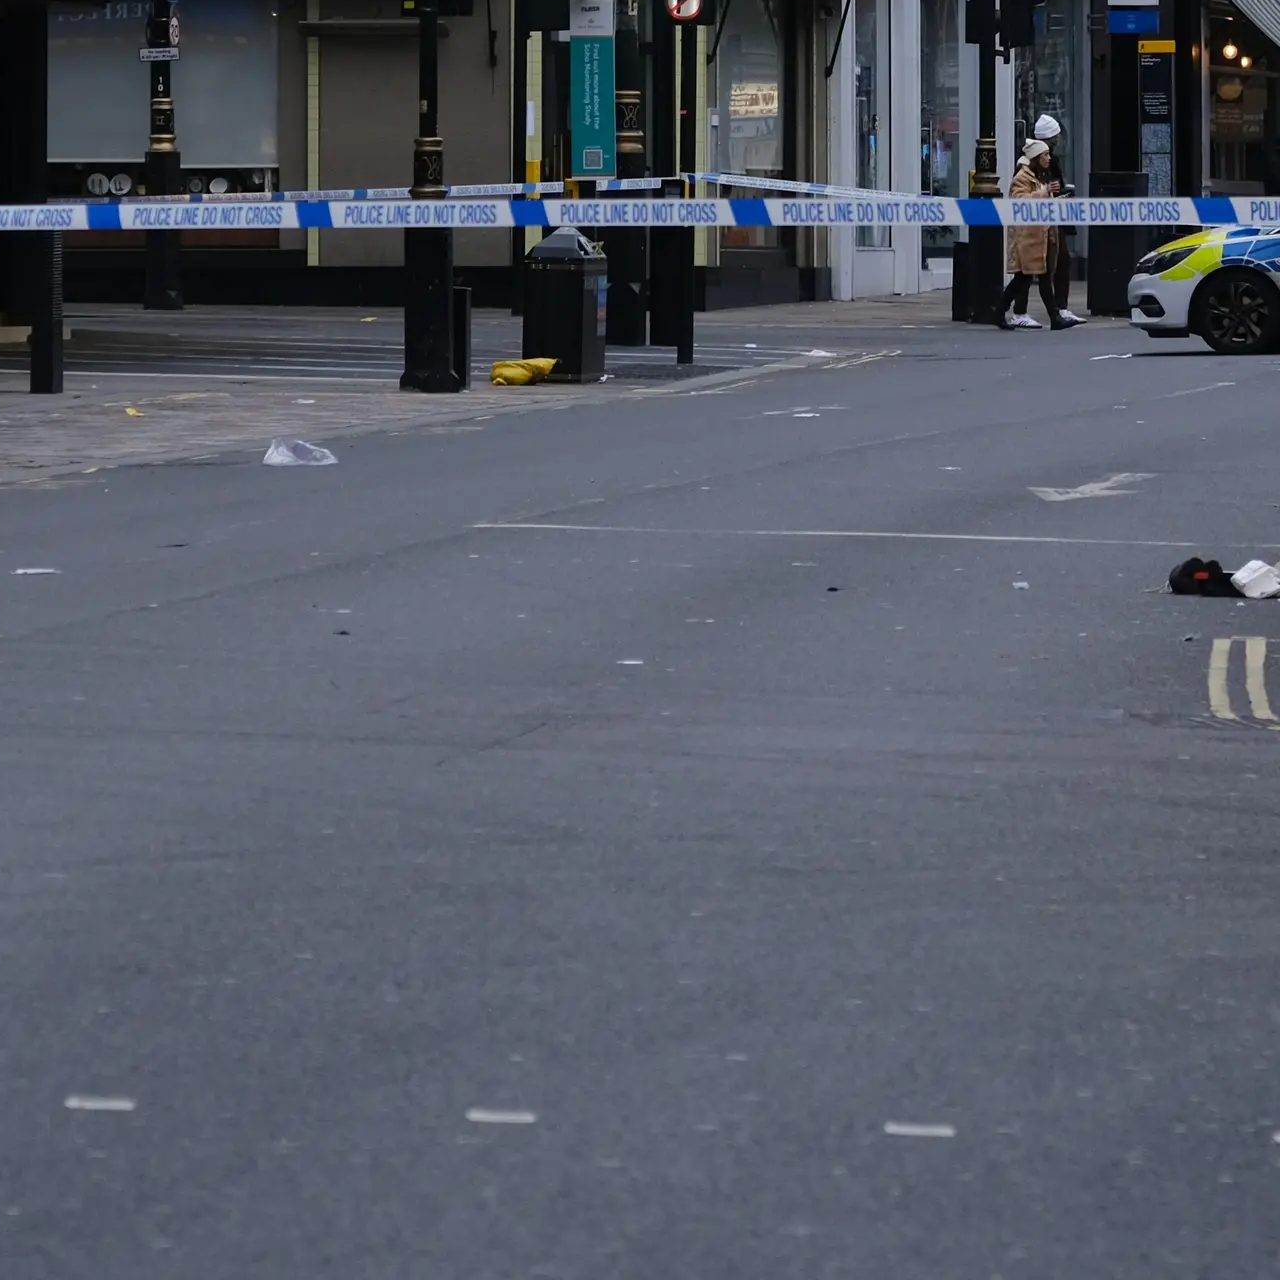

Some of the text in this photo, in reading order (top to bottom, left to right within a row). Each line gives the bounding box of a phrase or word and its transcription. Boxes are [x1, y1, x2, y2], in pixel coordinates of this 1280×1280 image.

[11, 208, 32, 226] NOT
[36, 207, 72, 226] CROSS
[133, 205, 283, 227] POLICE LINE DO NOT CROSS
[344, 204, 497, 225] POLICE LINE DO NOT CROSS
[561, 203, 717, 224] POLICE LINE DO NOT CROSS
[783, 202, 945, 223] POLICE LINE DO NOT CROSS
[1013, 202, 1180, 222] POLICE LINE DO NOT CROSS
